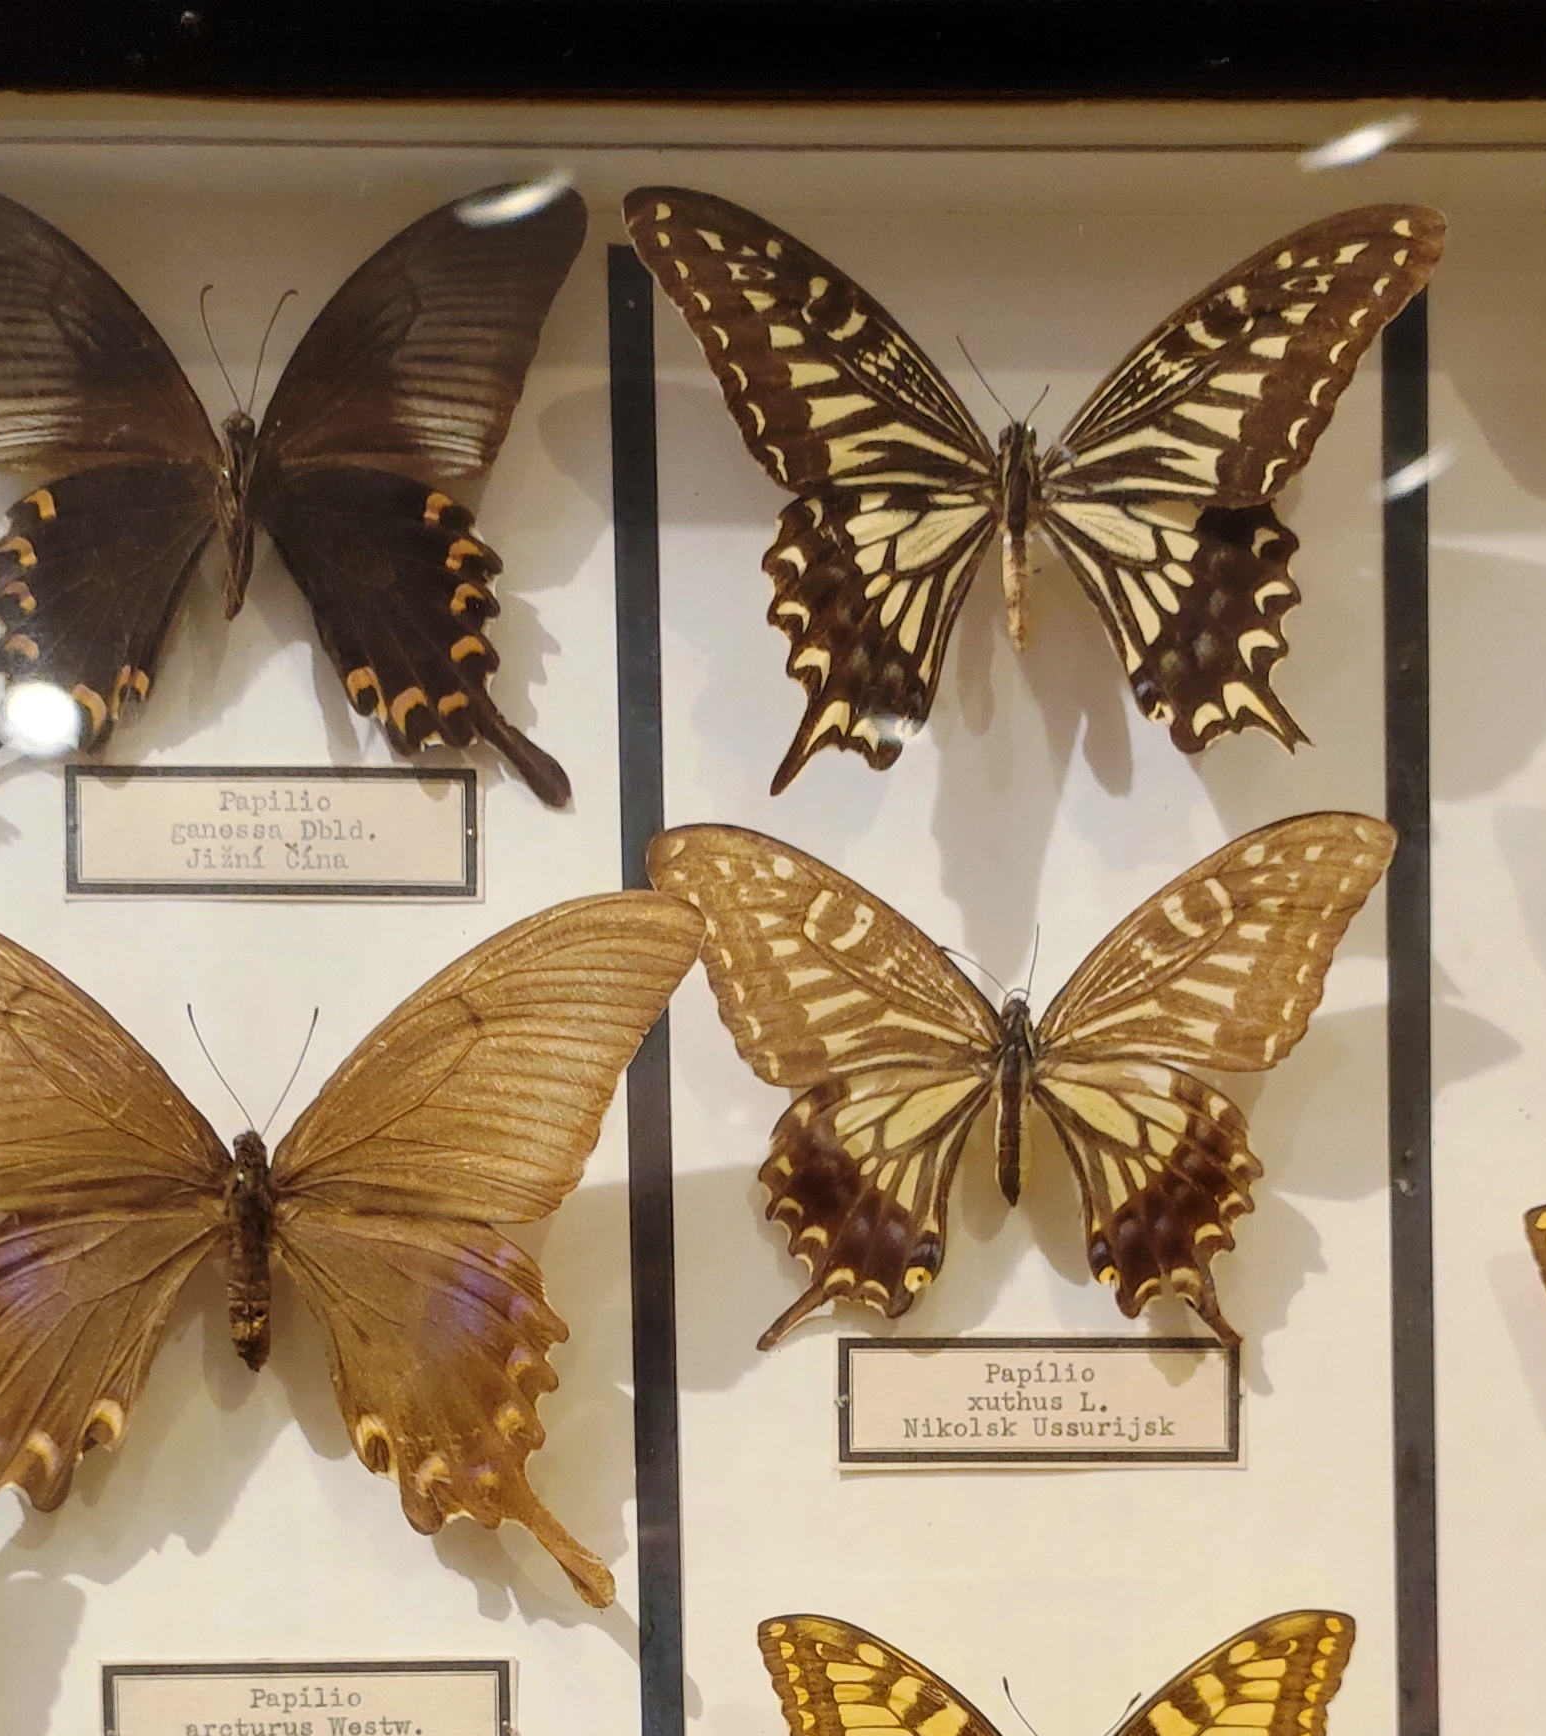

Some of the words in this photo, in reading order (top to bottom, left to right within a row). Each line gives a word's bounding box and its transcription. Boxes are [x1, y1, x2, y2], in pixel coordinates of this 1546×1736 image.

[218, 788, 332, 816] Papilio
[170, 820, 282, 846] ganessa
[299, 817, 379, 842] Dbld.
[185, 844, 266, 871] Jižní
[283, 840, 351, 871] Čína
[966, 1389, 1062, 1414] xuthus
[1078, 1389, 1109, 1413] L.
[903, 1415, 1017, 1439] Nikolsk
[1032, 1415, 1176, 1442] Ussurijsk
